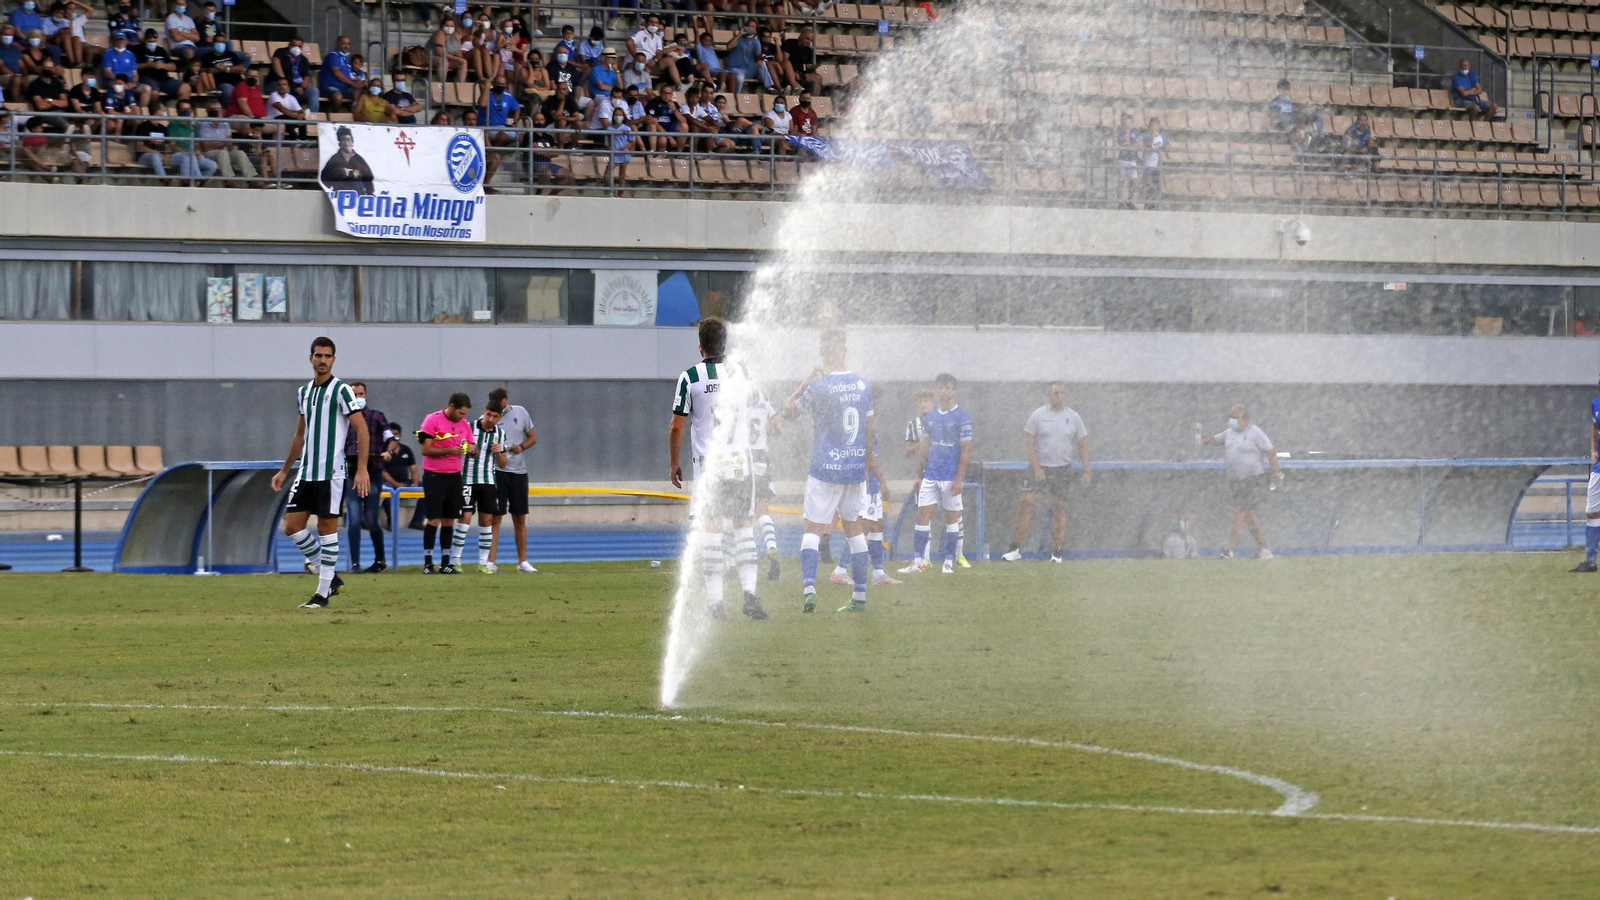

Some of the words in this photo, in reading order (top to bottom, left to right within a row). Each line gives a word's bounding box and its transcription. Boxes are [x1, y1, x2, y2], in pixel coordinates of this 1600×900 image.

[412, 192, 484, 226] Mingo"
[347, 221, 400, 237] Siempre
[402, 223, 421, 236] Con
[422, 224, 472, 238] Nosotros
[828, 382, 857, 394] indeso
[843, 406, 859, 446] 9
[462, 485, 472, 497] 21
